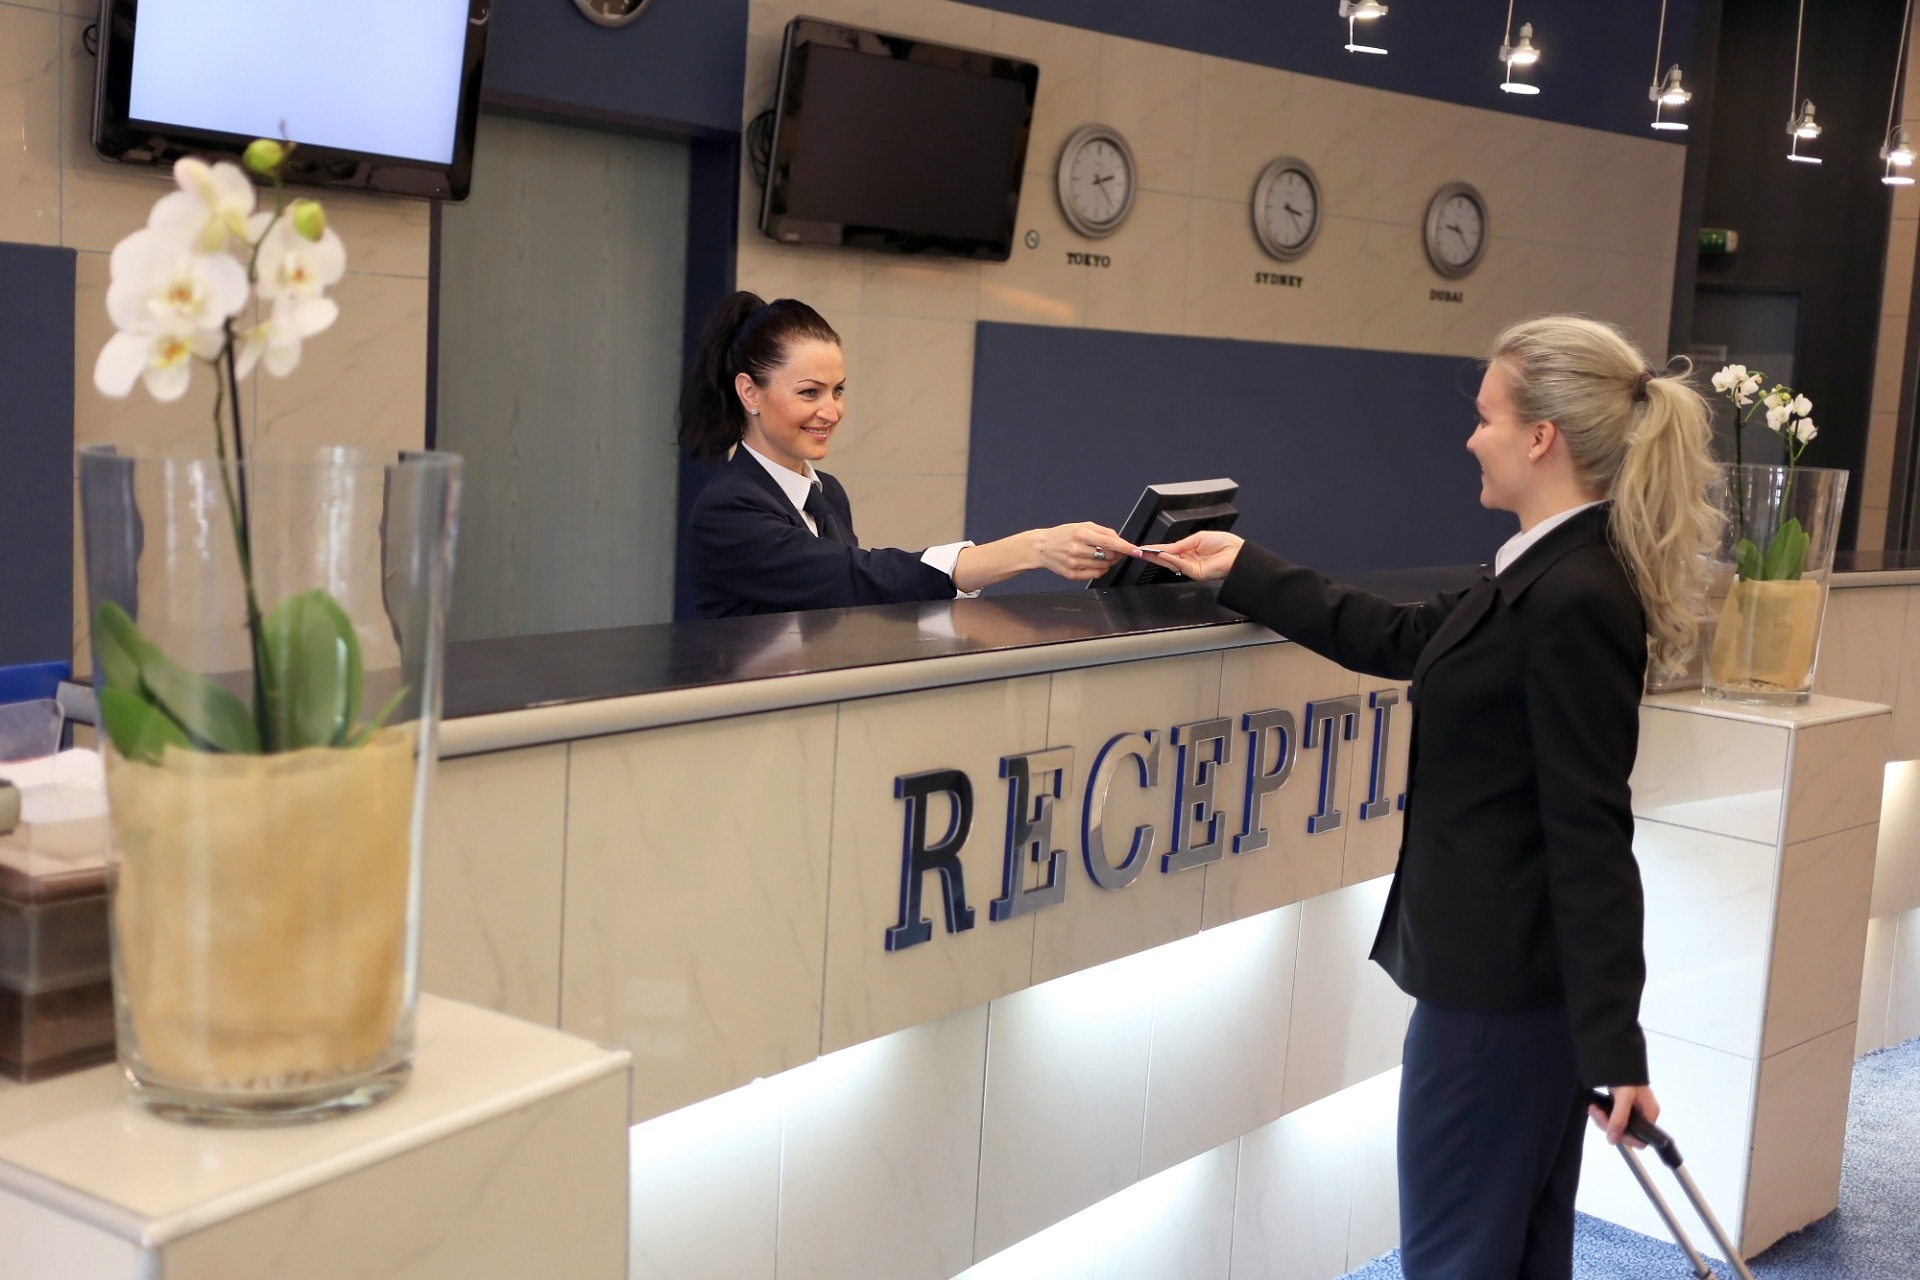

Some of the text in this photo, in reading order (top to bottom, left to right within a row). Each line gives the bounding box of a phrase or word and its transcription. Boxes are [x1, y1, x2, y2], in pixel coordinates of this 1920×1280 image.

[1066, 251, 1111, 268] TOKYO
[1255, 271, 1304, 288] SYDNEY
[1430, 289, 1463, 304] DUBAI
[885, 686, 1412, 951] RECEPTI
